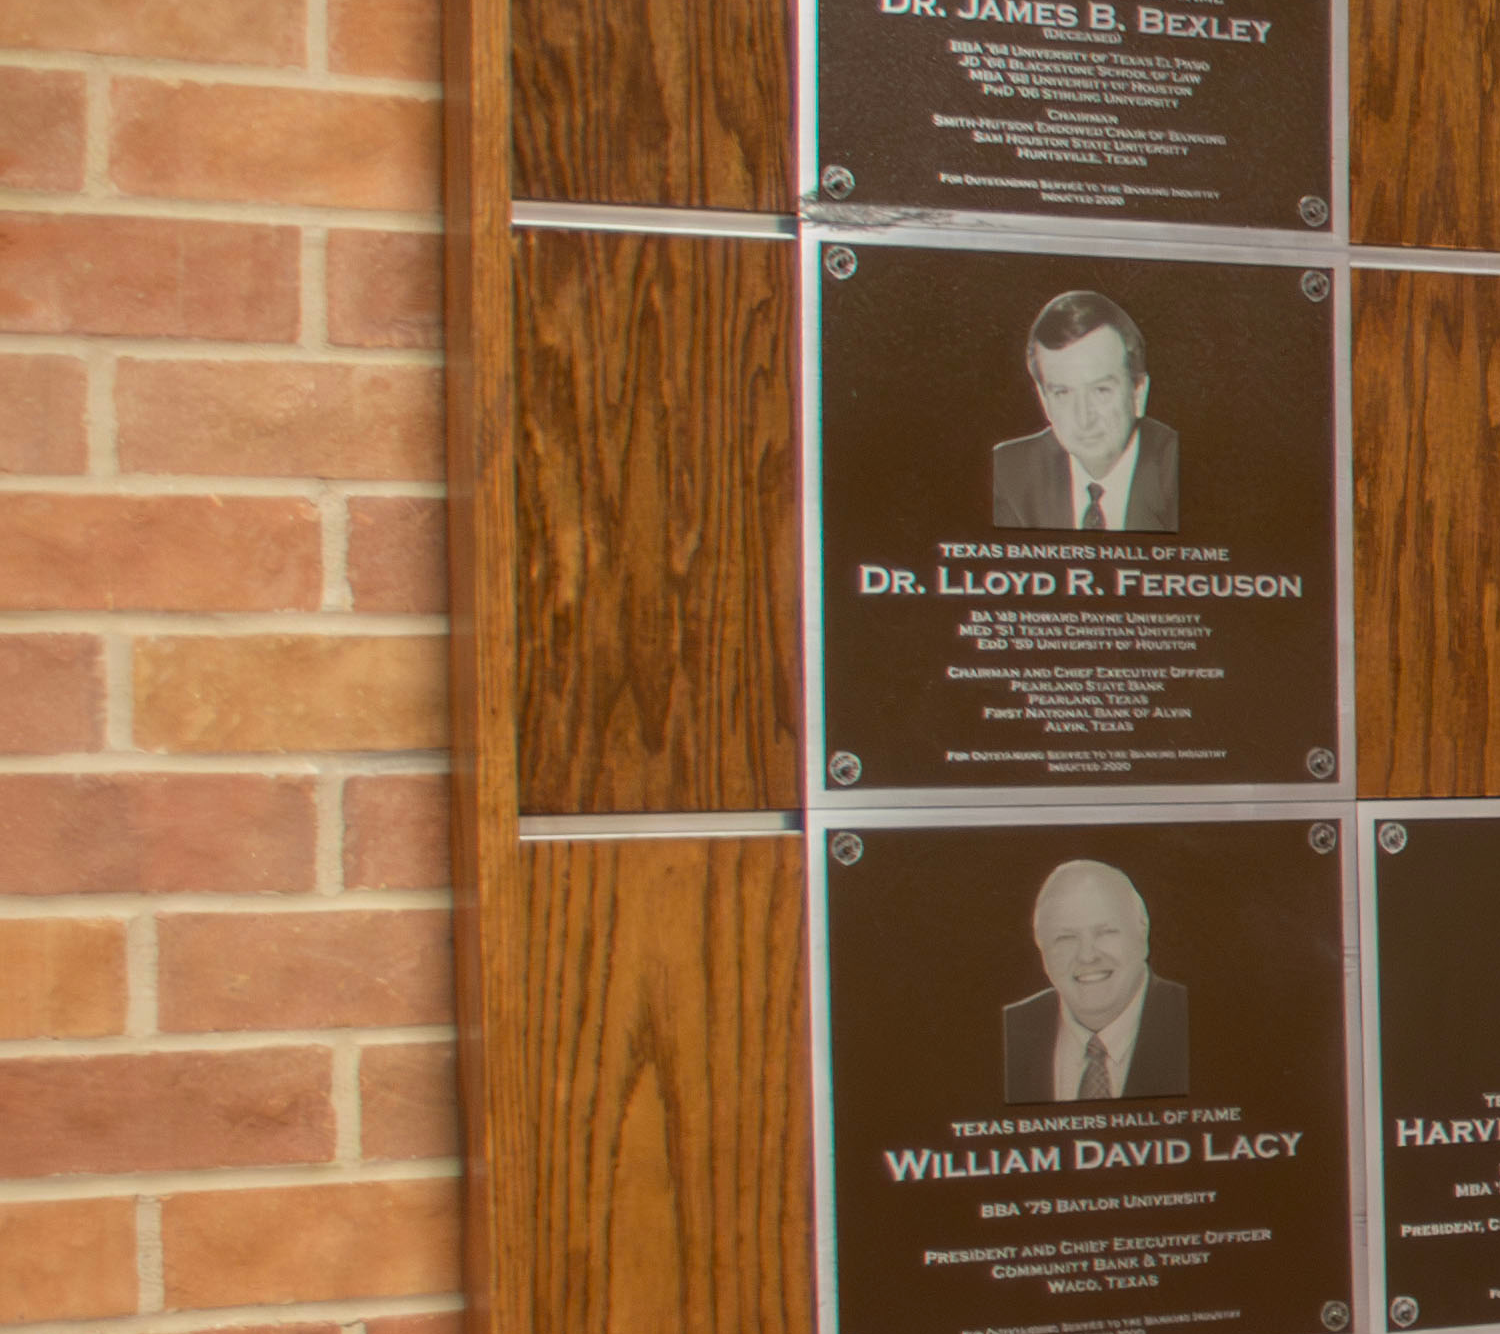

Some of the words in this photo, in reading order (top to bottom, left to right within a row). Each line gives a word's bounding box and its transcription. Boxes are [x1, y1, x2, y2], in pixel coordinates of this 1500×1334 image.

[1086, 2, 1125, 33] B.
[1138, 7, 1270, 42] BEXLEY
[939, 543, 1003, 558] TEXAS
[1007, 545, 1096, 559] BANKERS
[1100, 547, 1148, 560] HALL
[1152, 547, 1176, 560] OF
[1181, 548, 1228, 561] FAME
[860, 565, 925, 594] DR.
[938, 567, 1055, 595] LLOYD
[1067, 569, 1104, 595] R.
[1117, 570, 1301, 597] FERGUSON
[951, 1120, 1014, 1137] TEXAS
[1018, 1115, 1107, 1133] BANKERS
[1111, 1113, 1159, 1127] HALL
[1164, 1111, 1188, 1124] OF
[1192, 1108, 1240, 1122] FAME
[885, 1146, 1060, 1181] WILLIAM
[1075, 1140, 1190, 1169] DAVID
[1204, 1133, 1301, 1161] LACY
